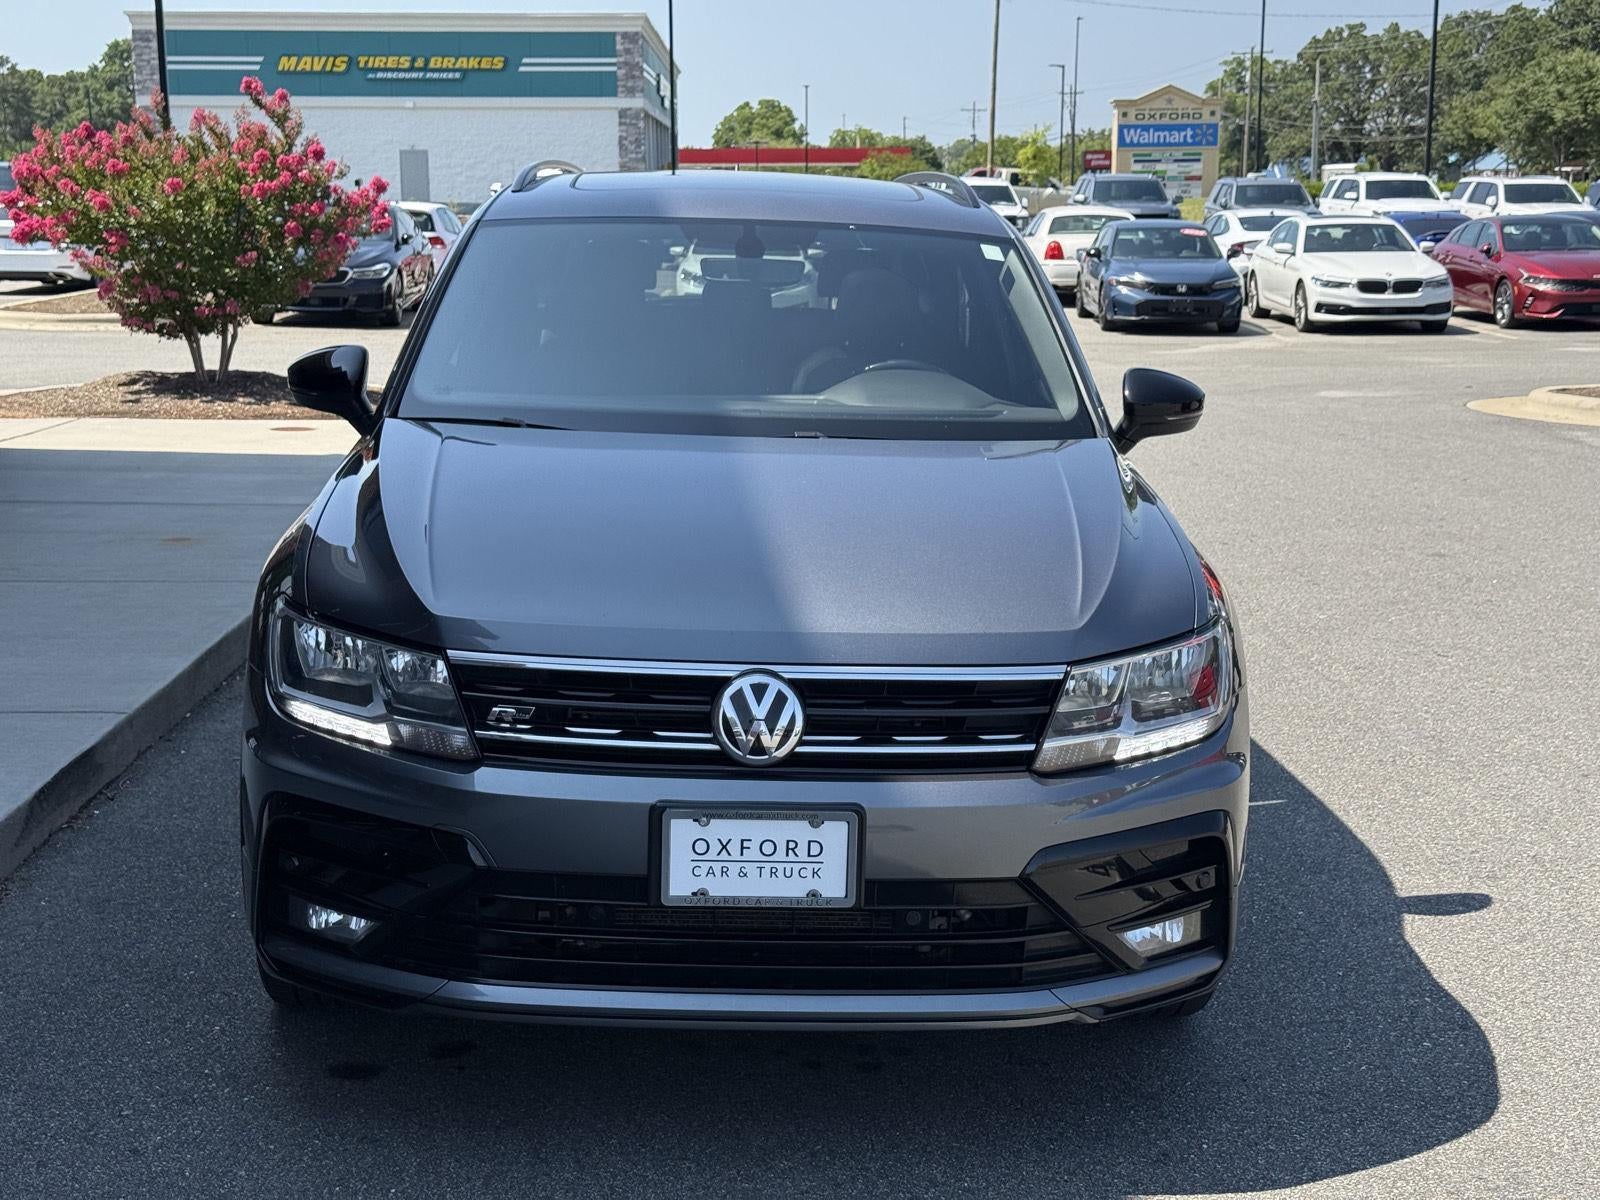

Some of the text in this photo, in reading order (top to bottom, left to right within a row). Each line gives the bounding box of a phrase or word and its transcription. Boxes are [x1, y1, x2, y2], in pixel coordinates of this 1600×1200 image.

[278, 56, 505, 72] MAVIS TIRES & BRAKES
[376, 71, 423, 79] DISCOUNT
[425, 71, 462, 79] PRICES
[1135, 112, 1203, 121] OXFORD
[1123, 127, 1194, 144] Walmart
[691, 837, 824, 858] OXFORD
[691, 865, 822, 879] CAR & TRUCK
[684, 897, 741, 906] OXFORD
[745, 898, 771, 906] CAR
[789, 899, 833, 907] TRUCK
